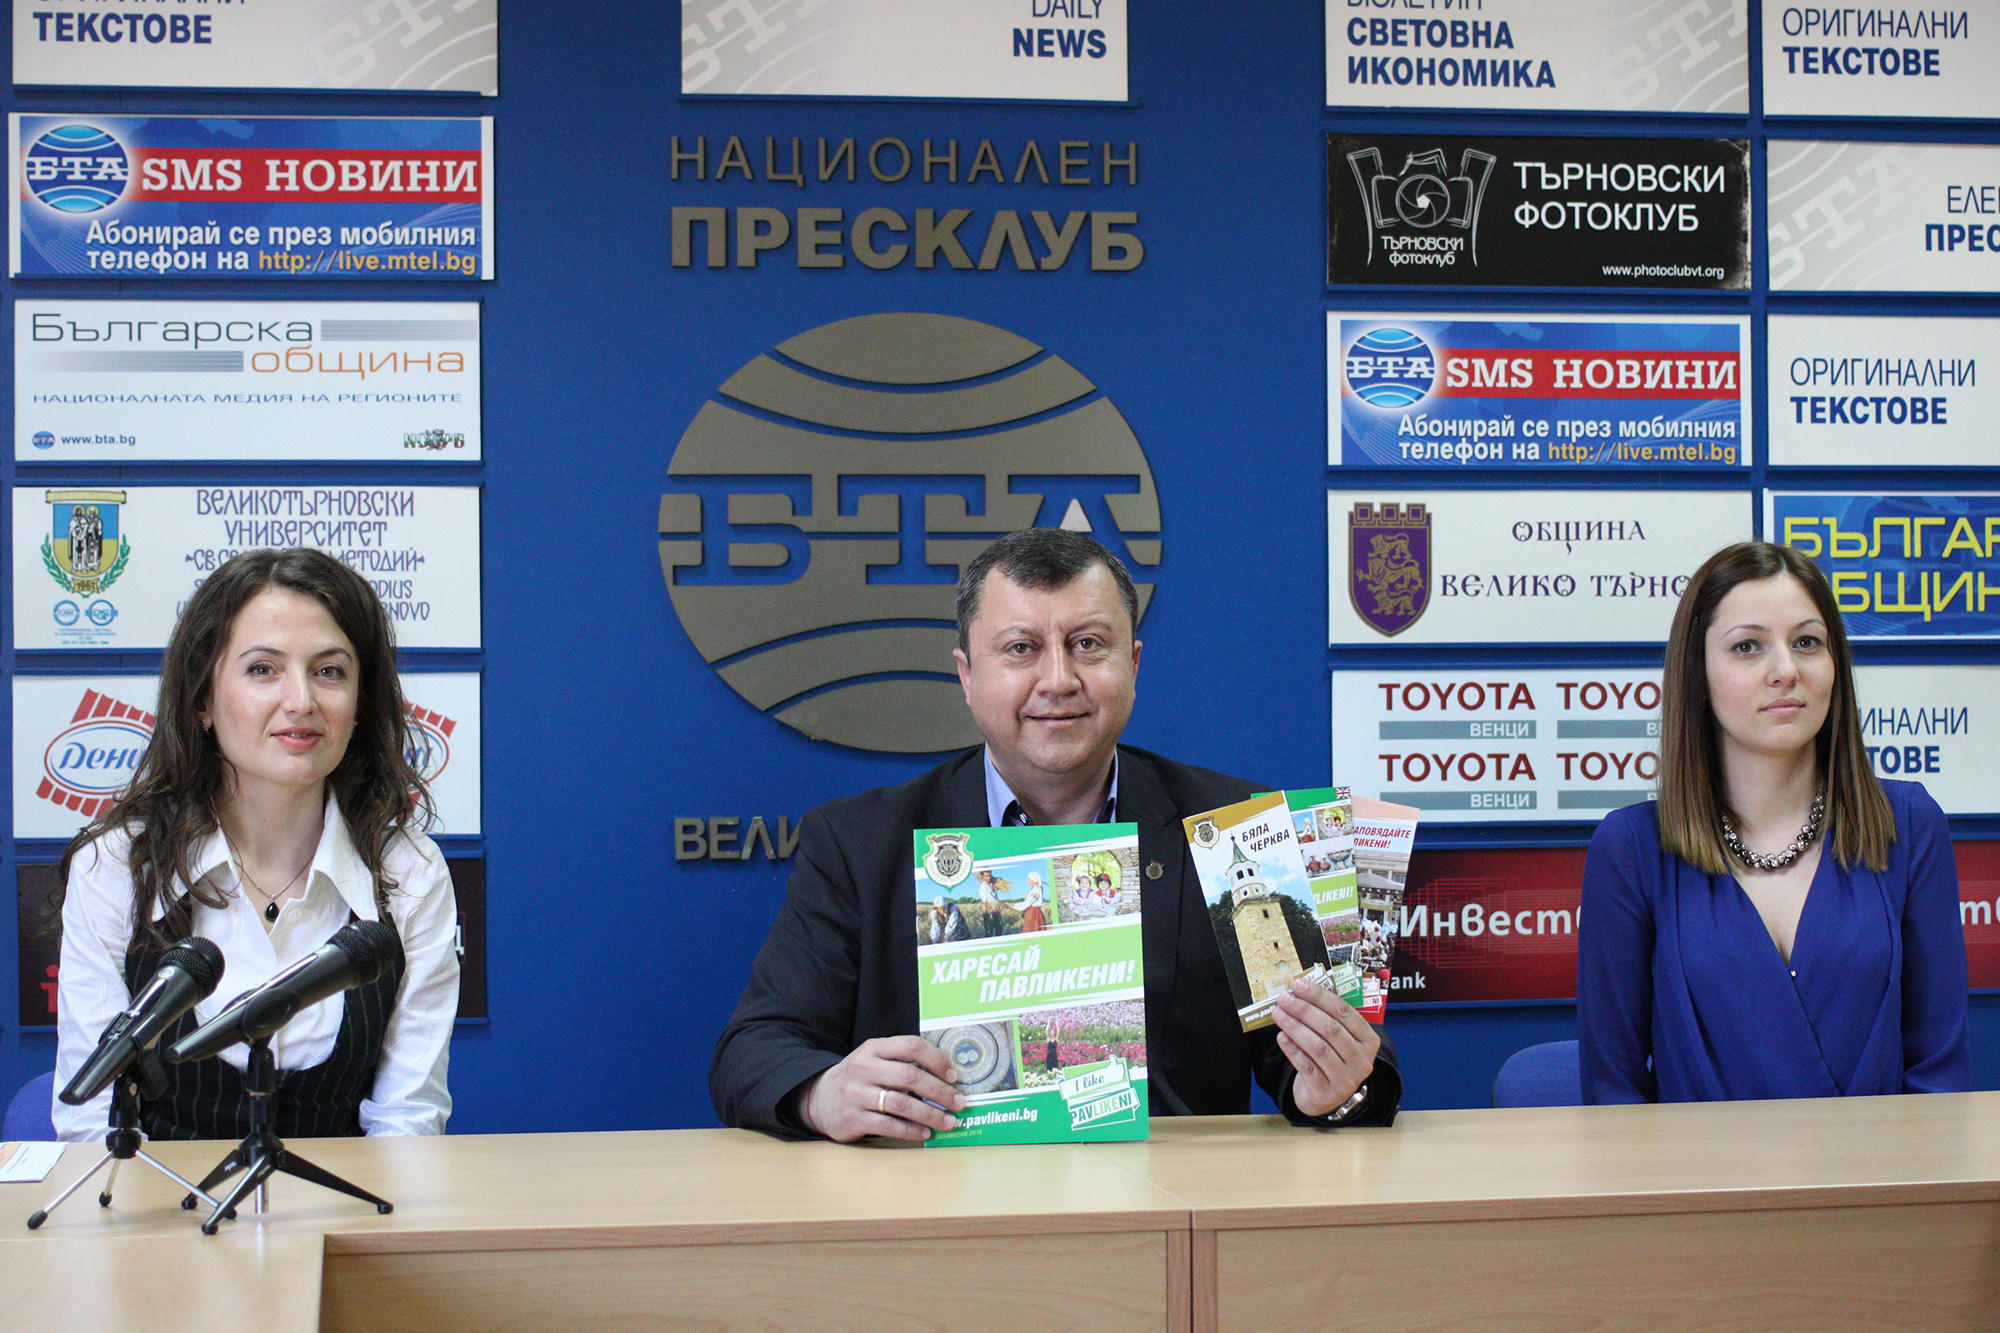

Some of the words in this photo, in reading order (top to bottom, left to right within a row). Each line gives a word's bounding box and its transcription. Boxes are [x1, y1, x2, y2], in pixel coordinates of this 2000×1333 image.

[1032, 0, 1103, 18] DAILY
[1782, 8, 1968, 39] ОРИГИНАЛНИ
[33, 12, 212, 44] ТЕКСТОВЕ
[1347, 17, 1515, 49] СВЕТОВНА
[1013, 28, 1107, 59] NEWS
[1347, 57, 1556, 88] ИКОНОМИКА
[1782, 46, 1940, 76] ТЕКСТОВЕ
[27, 157, 129, 180] БТА
[142, 158, 242, 191] SMS
[265, 159, 478, 192] НОВИНИ
[671, 136, 1138, 188] НАЦИОНАЛЕН
[1513, 162, 1726, 193] ТЪРНОВСКИ
[1947, 185, 2000, 213] ЕЛЕ
[1514, 201, 1699, 232] ФОТОКЛУБ
[86, 219, 221, 250] Абонирай
[228, 226, 261, 245] се
[268, 226, 332, 251] през
[341, 220, 475, 246] мобилния
[671, 206, 1145, 272] ПРЕСКЛУБ
[1381, 236, 1464, 251] ТЪРНОВСКИ
[87, 246, 207, 274] телефон
[217, 251, 249, 270] на
[258, 250, 476, 275] http://live.mtel.bg
[1388, 251, 1456, 268] фотоклуб
[1602, 264, 1725, 280] www.photoclubvt.org
[32, 313, 312, 349] Българска
[252, 344, 464, 380] община
[1346, 357, 1435, 378] БТА
[1446, 358, 1533, 388] SMS
[1552, 359, 1737, 390] НОВИНИ
[1790, 357, 1976, 387] ОРИГИНАЛНИ
[33, 394, 206, 404] НАЦИОНАЛНАТА
[214, 394, 293, 404] МЕДИЯ
[302, 394, 330, 403] НА
[338, 394, 463, 403] РЕГИОНИТЕ
[1790, 396, 1948, 425] ТЕКСТОВЕ
[61, 434, 136, 446] www.bta.bg
[1398, 414, 1515, 443] Абонирай
[1522, 420, 1549, 438] се
[1556, 420, 1612, 443] през
[1618, 415, 1736, 438] мобилния
[1399, 438, 1503, 465] телефон
[1512, 443, 1540, 460] на
[1548, 442, 1736, 465] http://live.mtel.bg
[196, 488, 415, 516] ВЕЛИКОТЪРНОВСКИ
[224, 520, 388, 546] УНИВЕРСИТЕТ
[1512, 520, 1646, 555] ОБЩИНА
[1440, 573, 1577, 597] ВЕЛИКО
[1822, 571, 2000, 622] БЩИН
[1378, 682, 1536, 711] TOYOTA
[1470, 723, 1530, 739] ВЕНЦИ
[1378, 753, 1536, 782] TOYOTA
[1470, 793, 1530, 809] ВЕНЦИ
[1242, 823, 1270, 842] БЯЛА
[1250, 829, 1290, 853] ЧЕРКВА
[1352, 826, 1412, 838] АПОВЯДАЙТЕ
[1400, 903, 1581, 938] Инвест
[930, 945, 1041, 985] ХАРЕСАЙ
[979, 960, 1136, 1003] ПАВЛИКЕНИ!
[1390, 971, 1426, 989] ank
[1083, 1074, 1104, 1089] like
[1071, 1091, 1133, 1122] PAVLIKENI
